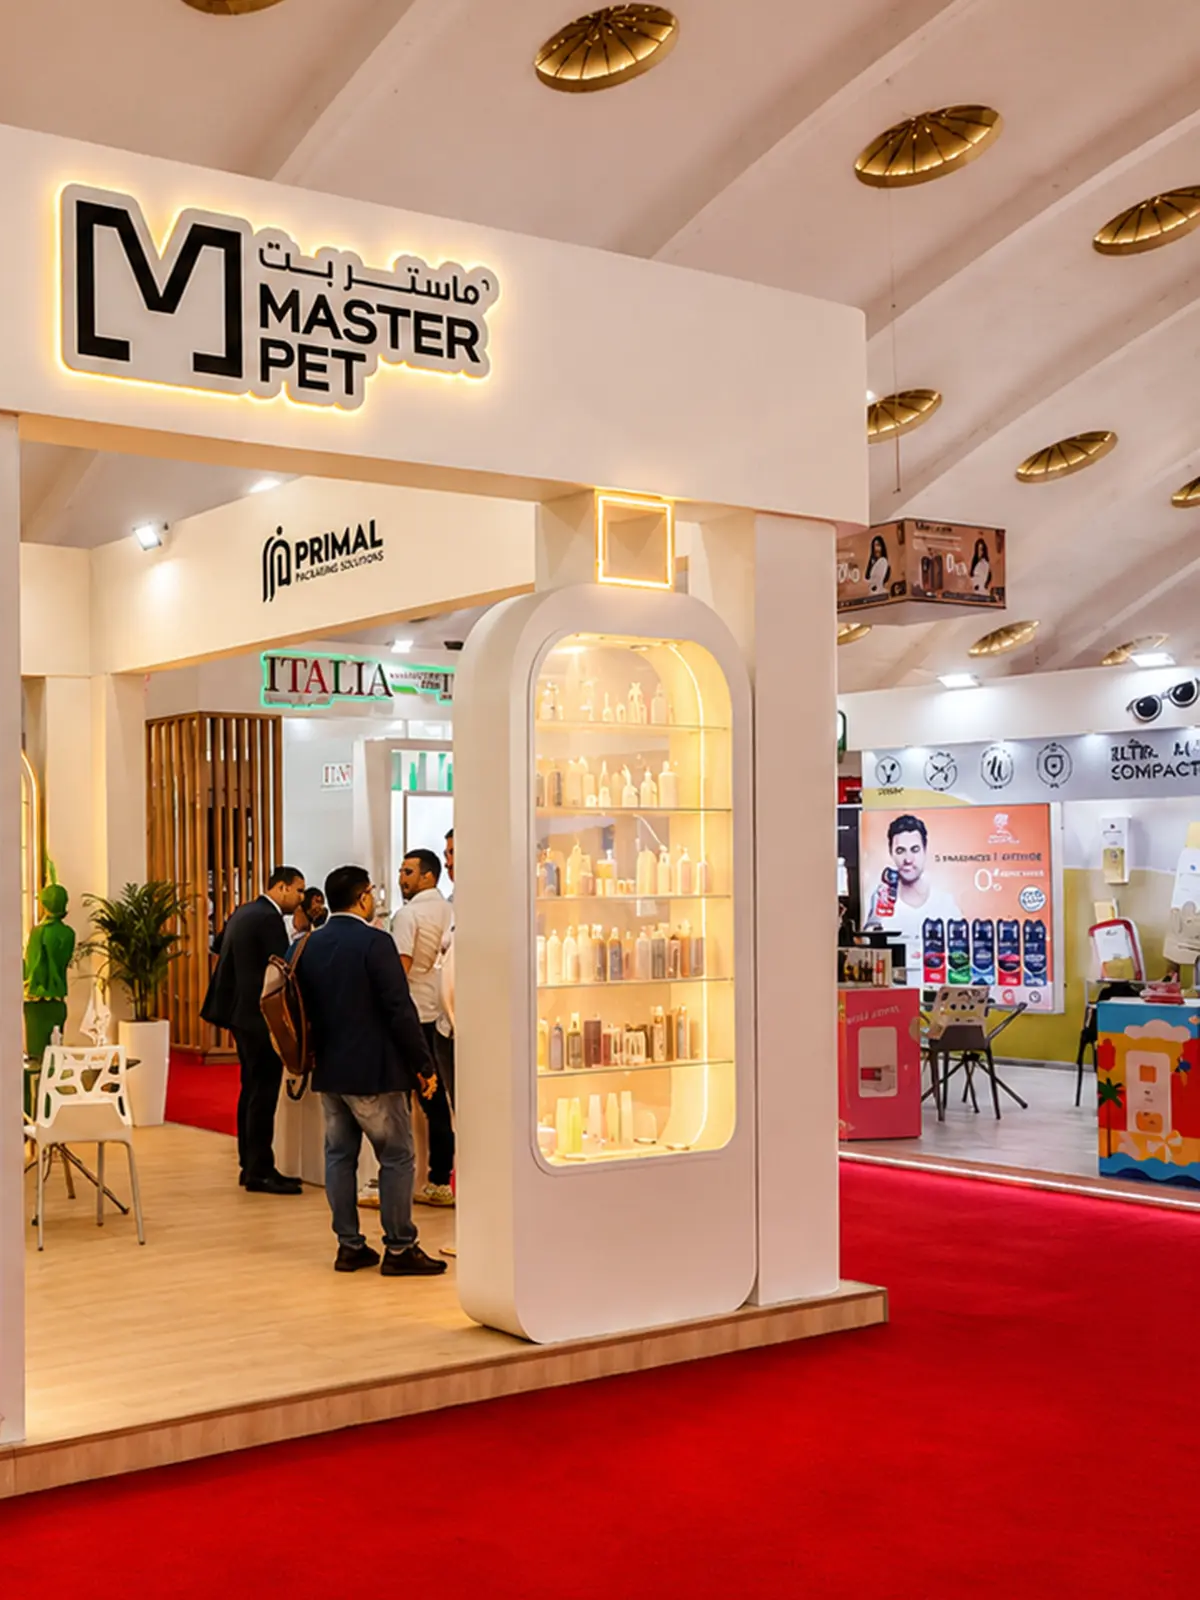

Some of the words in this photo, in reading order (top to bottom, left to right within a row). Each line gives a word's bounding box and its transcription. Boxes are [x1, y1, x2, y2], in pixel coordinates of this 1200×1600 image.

[259, 283, 481, 363] MASTER
[259, 337, 367, 396] PET
[295, 519, 384, 569] PRIMAL
[295, 562, 339, 583] PACKAGING
[340, 550, 385, 573] SOLUTIONS
[264, 656, 394, 697] ITALIA
